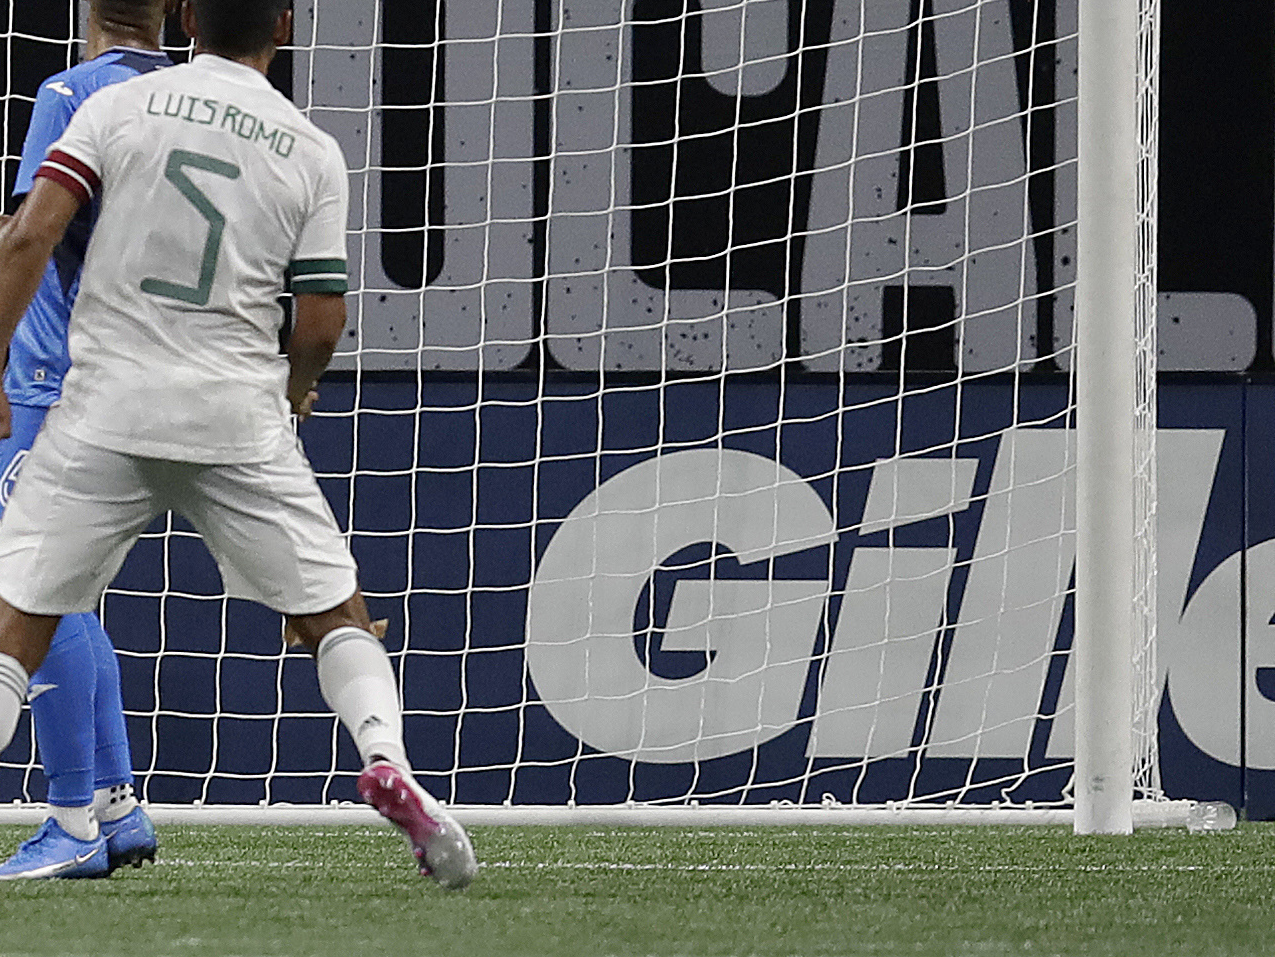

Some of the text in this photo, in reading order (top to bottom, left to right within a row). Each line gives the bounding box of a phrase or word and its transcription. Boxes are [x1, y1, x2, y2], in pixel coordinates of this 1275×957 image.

[146, 92, 296, 159] LUIS ROMO
[140, 148, 240, 307] 5
